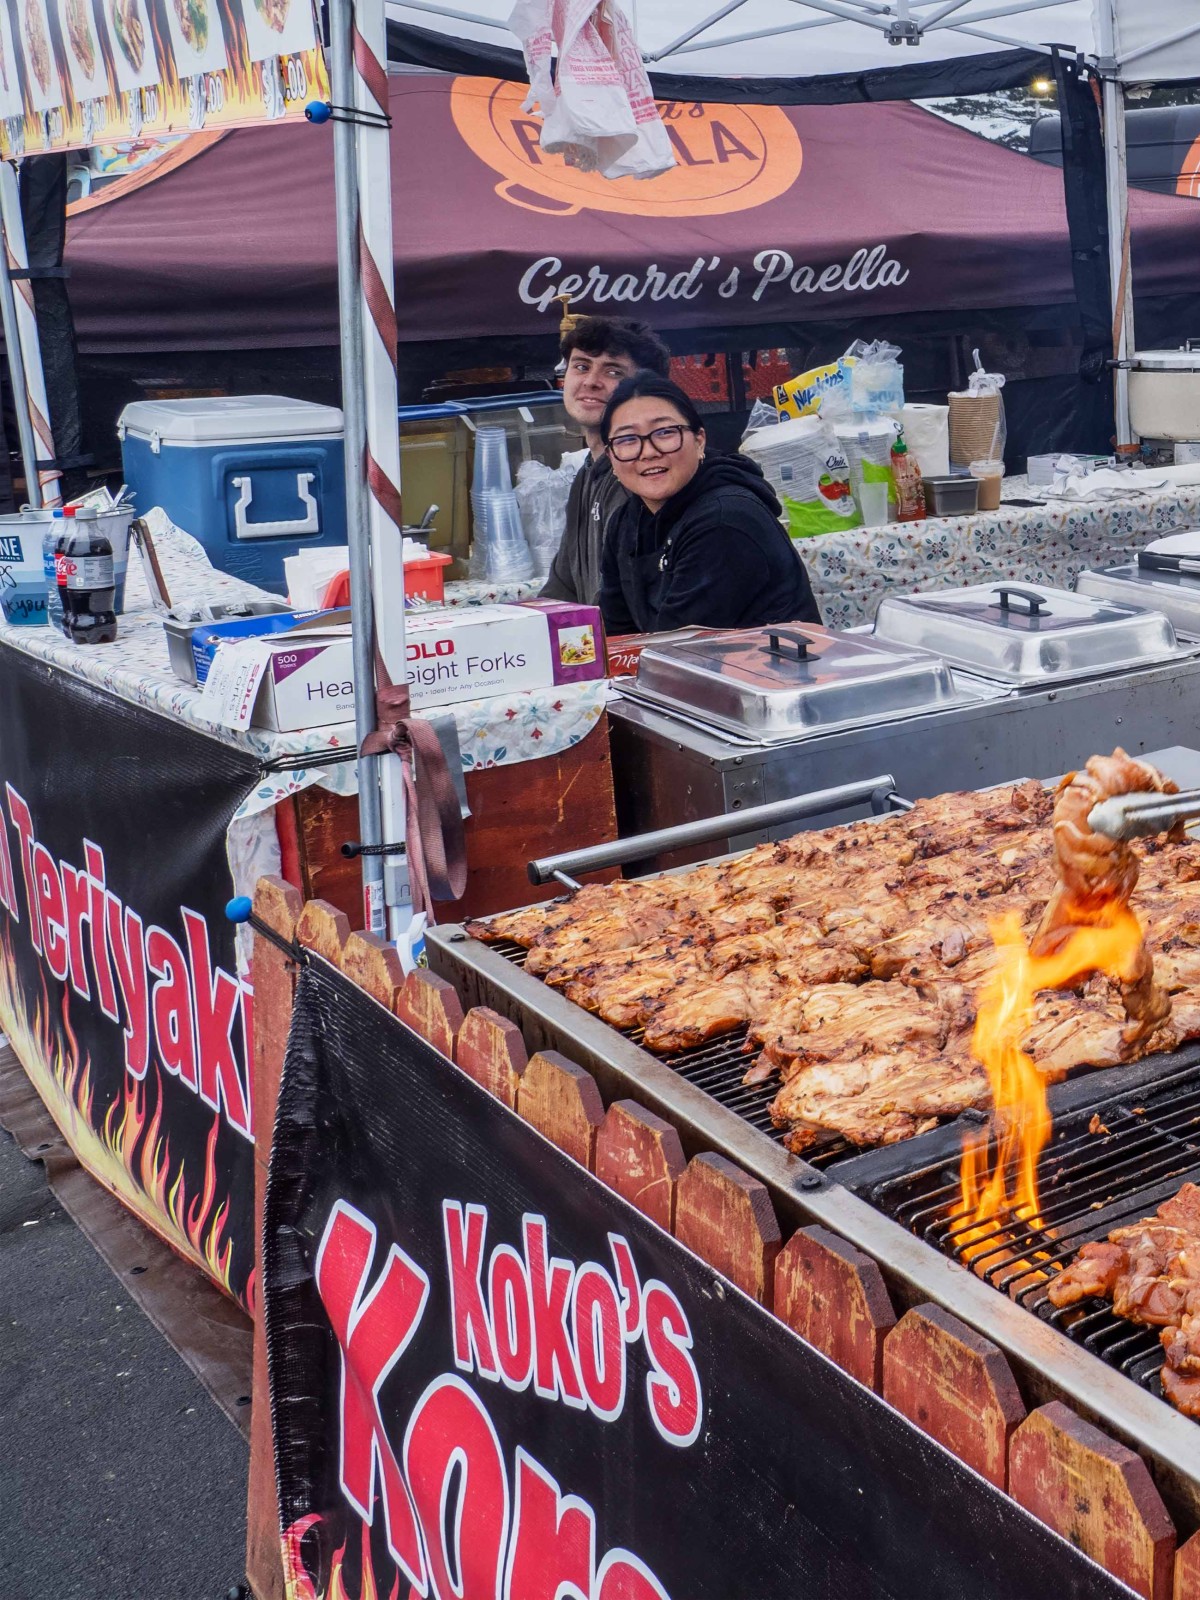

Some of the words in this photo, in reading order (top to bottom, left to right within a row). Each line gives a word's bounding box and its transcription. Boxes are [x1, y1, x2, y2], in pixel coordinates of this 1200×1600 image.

[518, 255, 740, 312] Gerard's
[752, 244, 909, 302] Paella
[277, 654, 298, 664] 500
[406, 638, 455, 662] OLO
[467, 651, 527, 675] Forks
[240, 663, 260, 720] SOLO
[459, 683, 472, 691] Any
[474, 678, 505, 688] Occasion
[443, 1200, 702, 1447] Koko's
